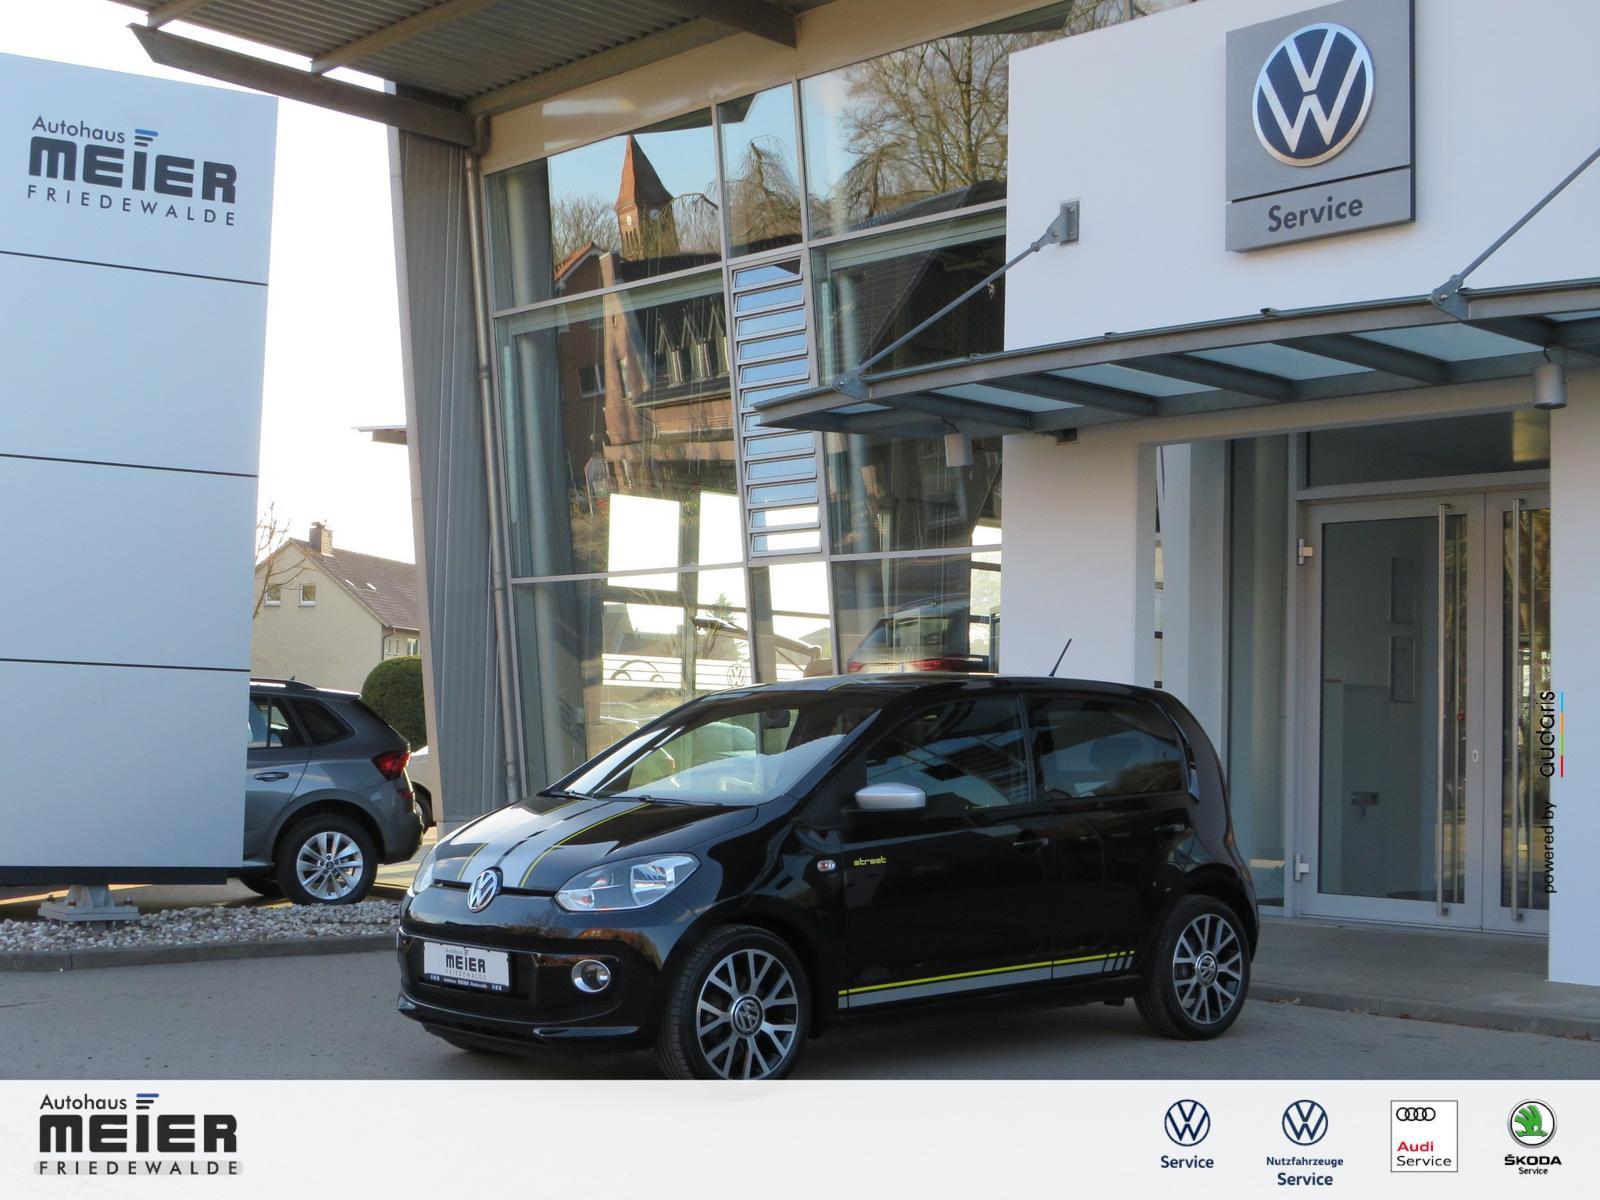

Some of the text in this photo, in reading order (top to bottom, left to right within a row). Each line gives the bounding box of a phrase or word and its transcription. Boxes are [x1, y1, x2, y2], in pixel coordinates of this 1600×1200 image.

[32, 115, 125, 143] Autohaus
[28, 135, 237, 204] MEIER
[27, 184, 235, 226] FRIEDEWALDE
[1267, 196, 1363, 232] Service
[854, 856, 887, 866] street
[446, 954, 486, 973] MEIER
